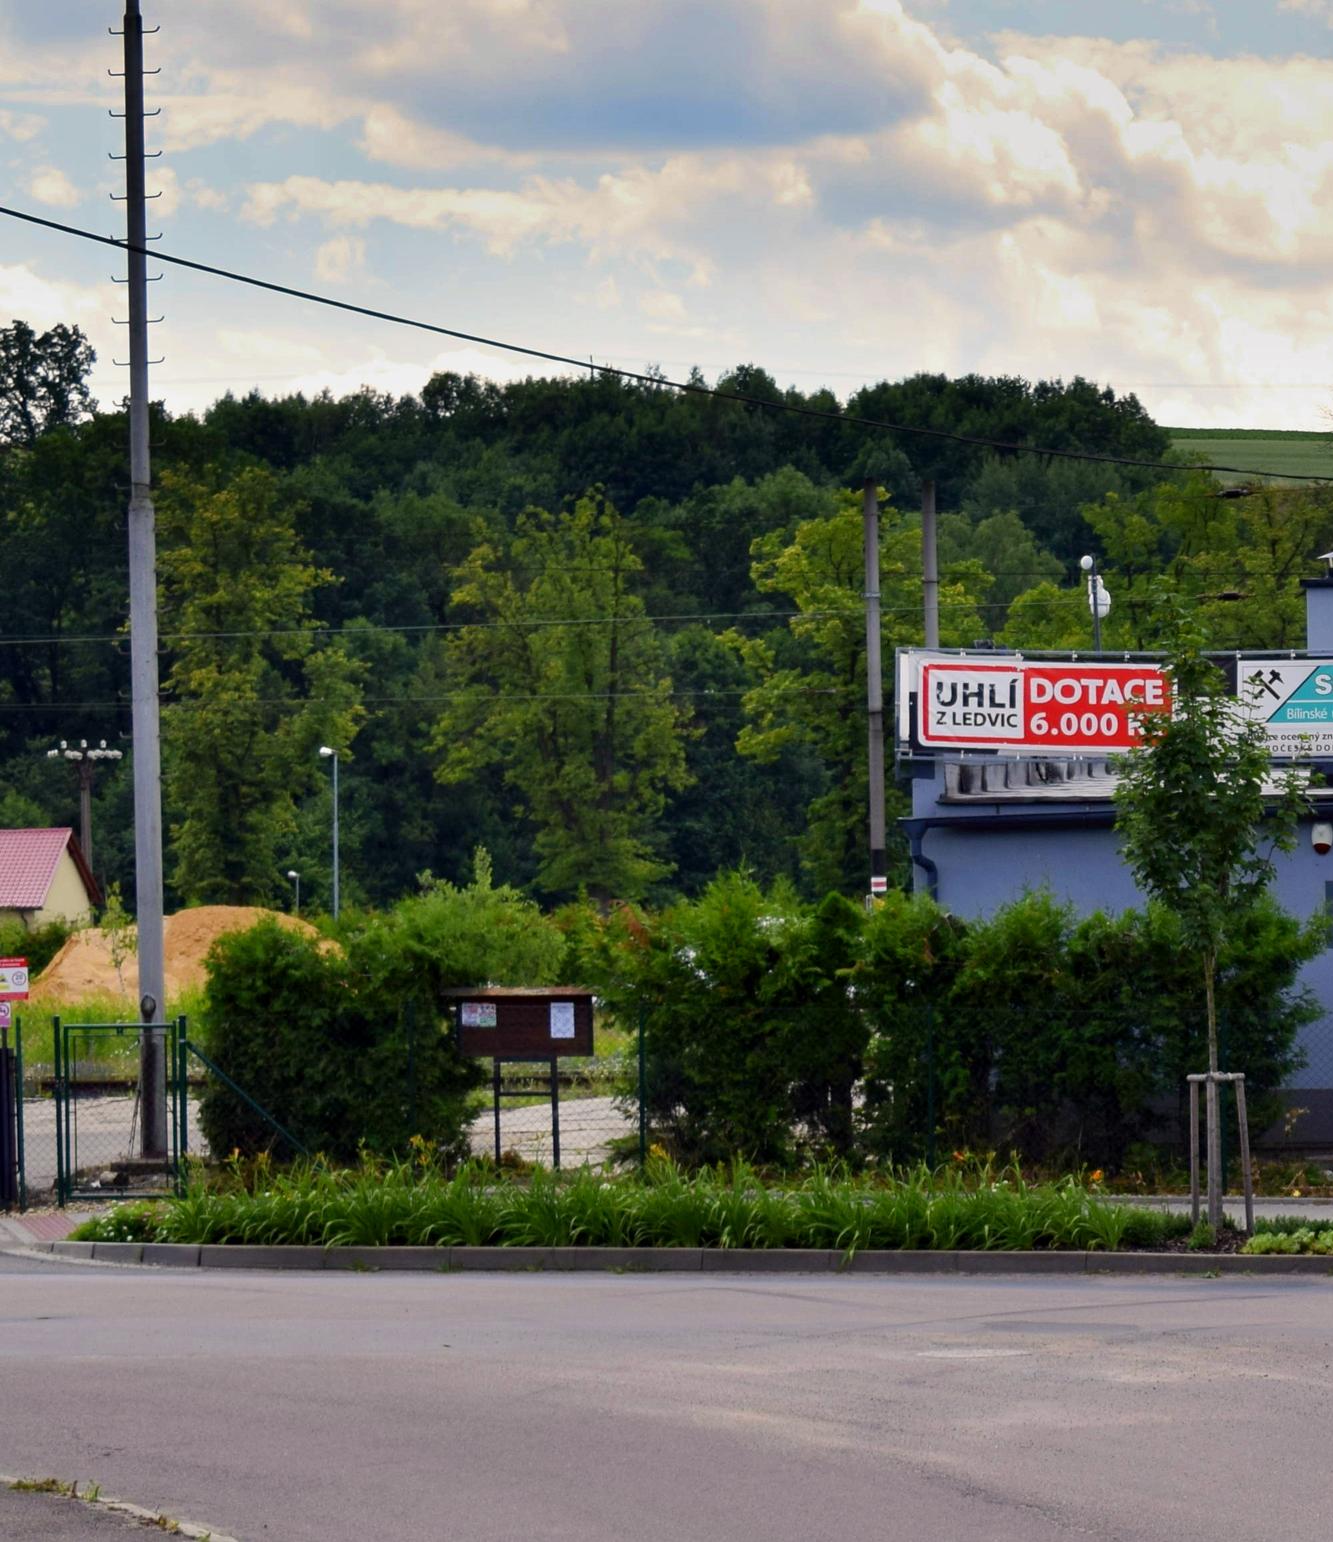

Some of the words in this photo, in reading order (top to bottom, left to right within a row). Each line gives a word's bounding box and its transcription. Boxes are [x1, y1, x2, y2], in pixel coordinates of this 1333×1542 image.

[936, 679, 1019, 709] UHLÍ
[1029, 677, 1164, 705] DOTACE
[936, 711, 947, 726] Z
[952, 712, 1018, 728] LEDVIC
[1030, 712, 1119, 736] 6.000
[1287, 706, 1328, 720] Bílinské
